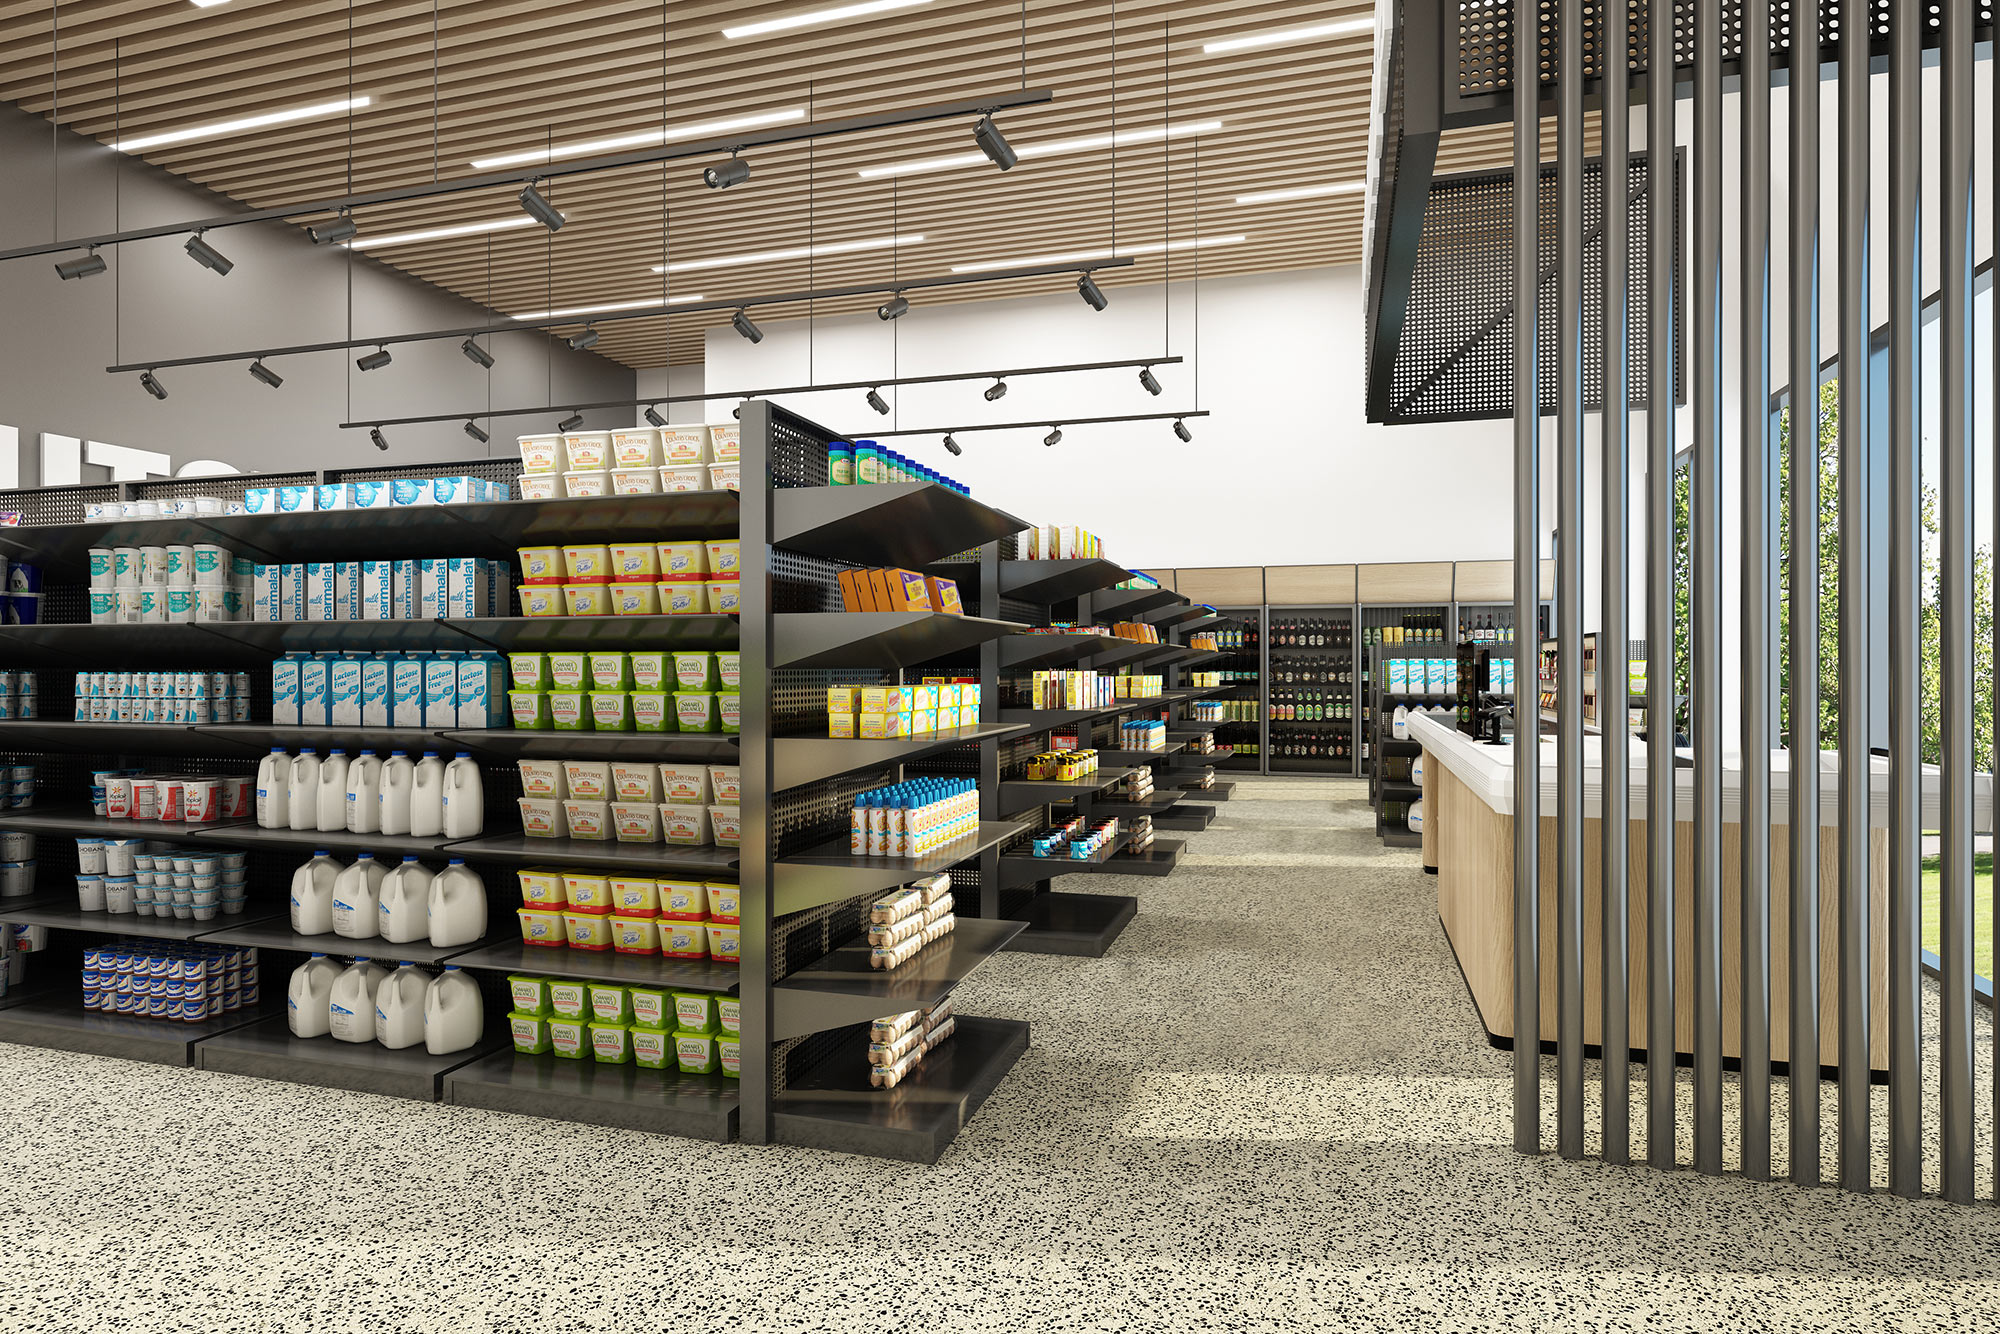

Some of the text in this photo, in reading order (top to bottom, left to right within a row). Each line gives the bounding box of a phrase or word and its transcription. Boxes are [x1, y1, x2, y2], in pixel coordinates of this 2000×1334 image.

[268, 567, 278, 621] parmalat
[293, 567, 301, 621] parmalat
[322, 566, 332, 620] parmalat
[349, 565, 357, 620] parmalat
[378, 563, 388, 619] parmalat
[436, 561, 445, 619] parmalat
[463, 561, 473, 618] parmalat
[275, 669, 295, 680] Lactose
[304, 669, 323, 680] Lactose
[334, 669, 357, 680] Lactose
[365, 669, 384, 680] Lactose
[396, 669, 418, 680] Lactose
[428, 669, 452, 681] Lactose
[460, 669, 483, 681] Lactose
[275, 680, 285, 688] Free
[304, 680, 314, 688] Free
[334, 680, 347, 688] Free
[365, 680, 375, 689] Free
[396, 681, 408, 689] Free
[428, 681, 441, 689] Free
[460, 681, 472, 689] Free
